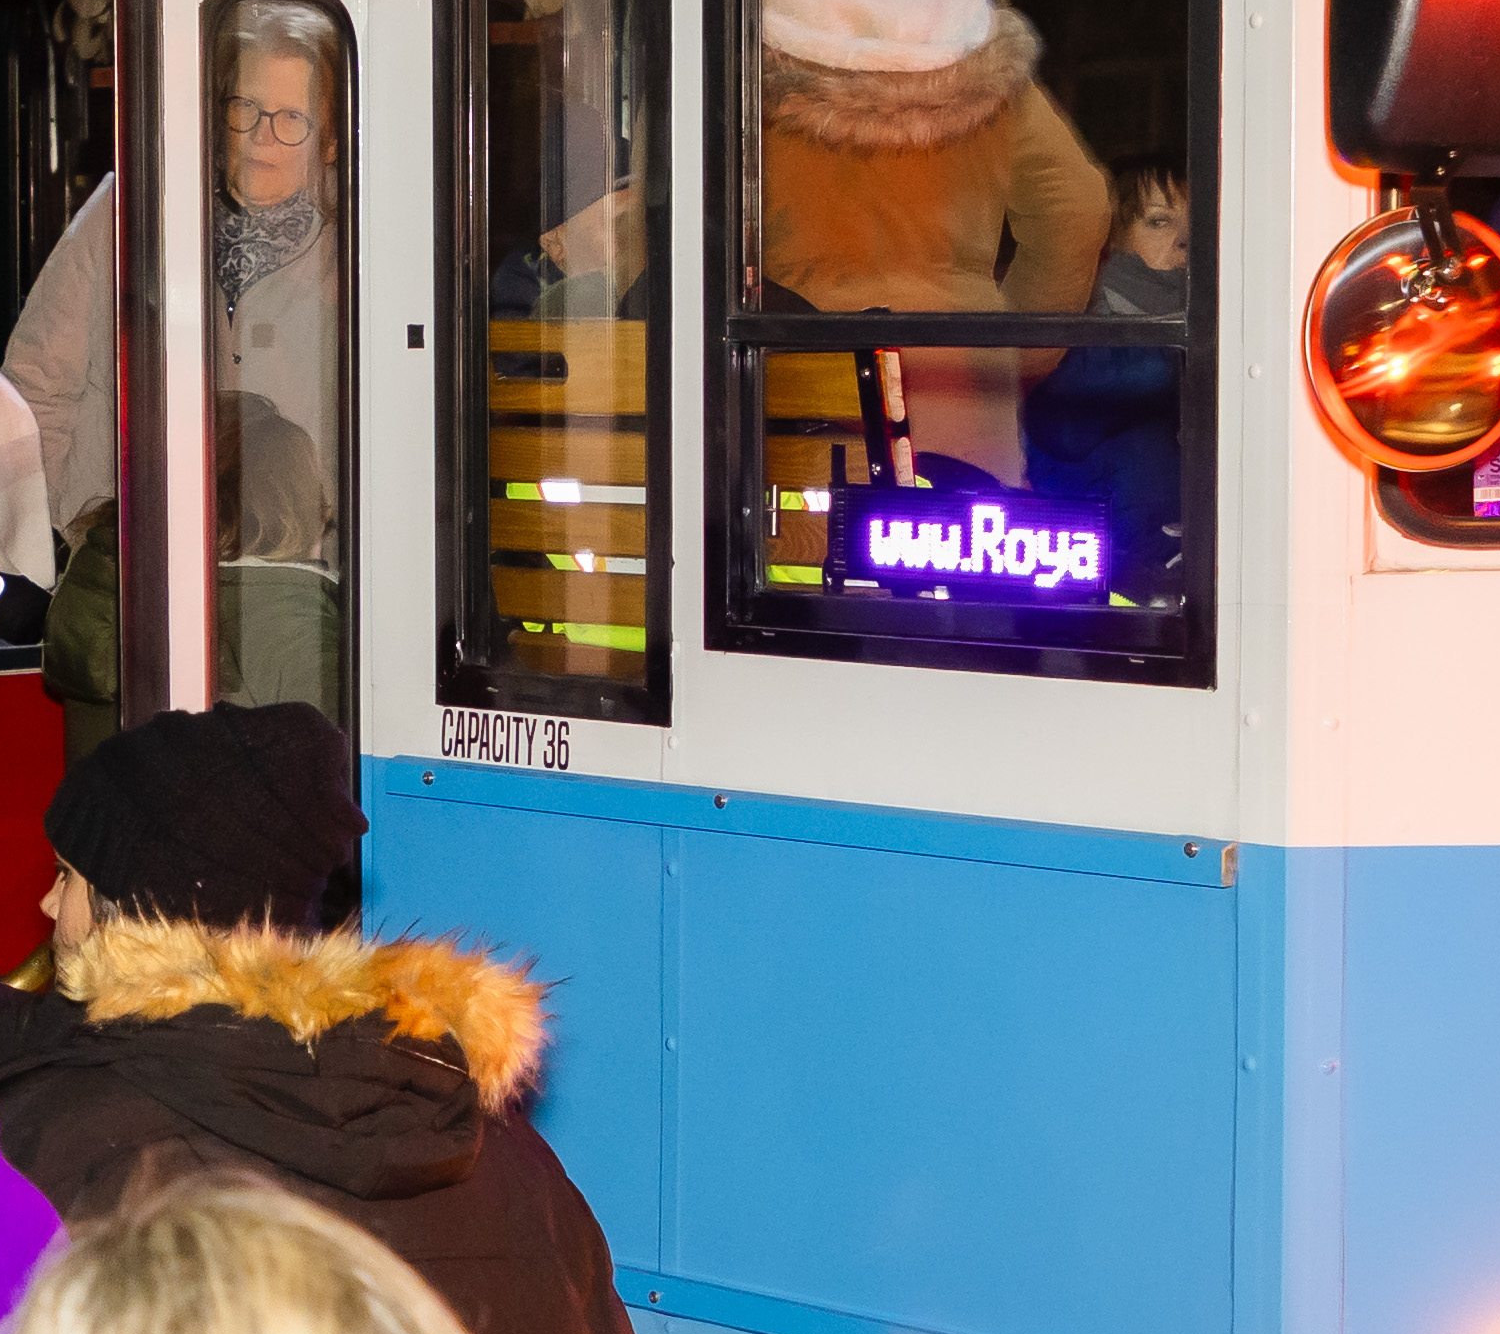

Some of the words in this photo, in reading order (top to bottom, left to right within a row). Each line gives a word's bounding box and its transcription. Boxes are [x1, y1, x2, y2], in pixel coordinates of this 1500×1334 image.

[867, 503, 1101, 589] www.Roya
[441, 708, 538, 766] CAPACITY
[543, 719, 571, 771] 36
